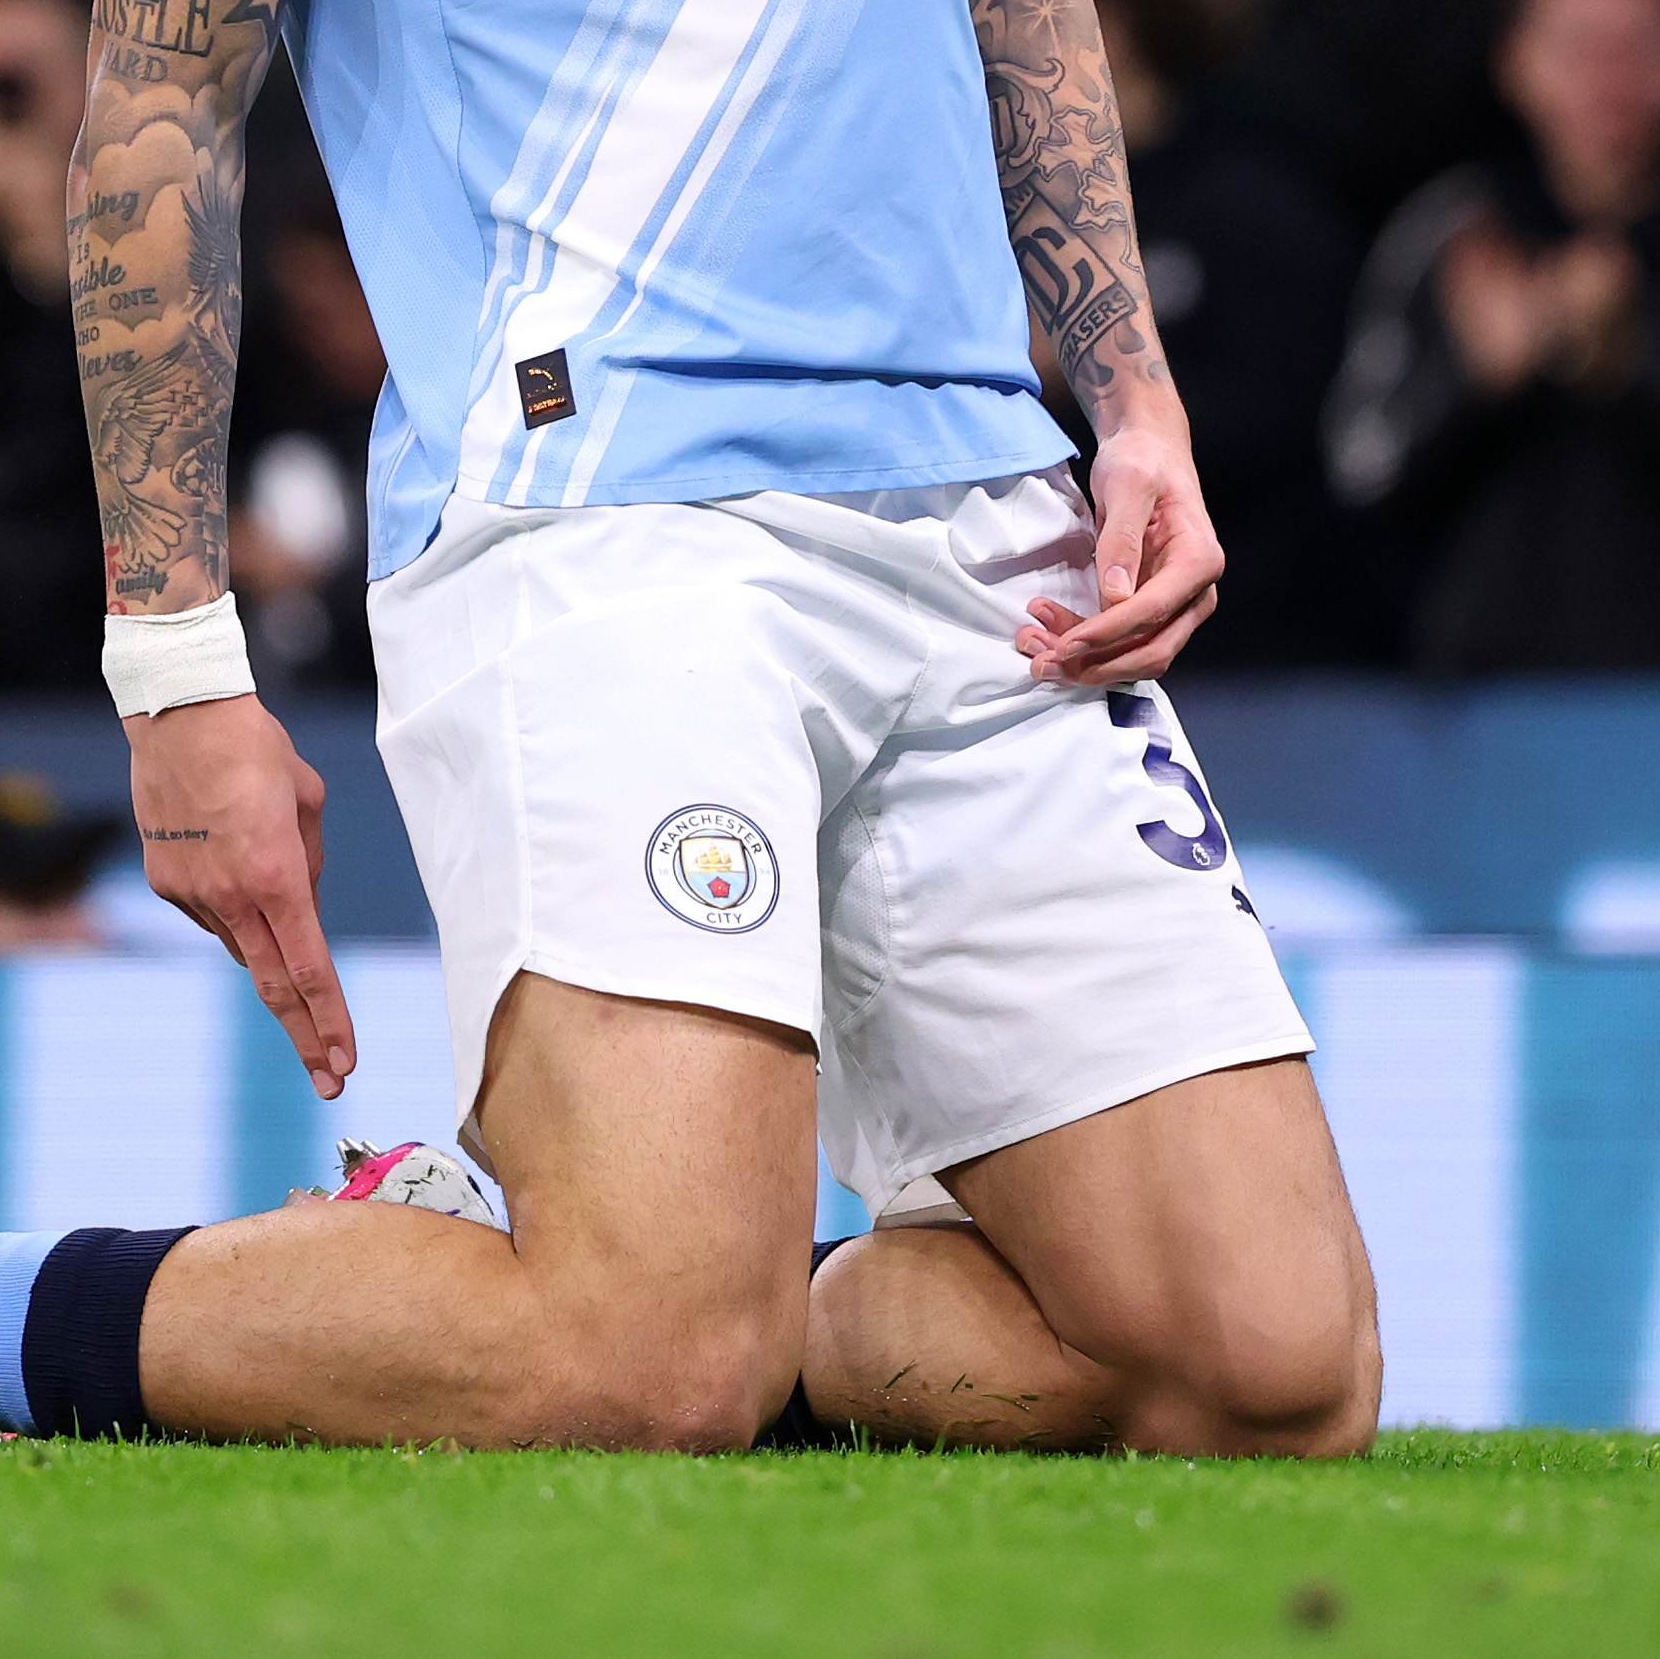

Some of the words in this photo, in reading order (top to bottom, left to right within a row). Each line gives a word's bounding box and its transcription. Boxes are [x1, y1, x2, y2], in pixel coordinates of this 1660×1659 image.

[108, 286, 159, 312] ONE
[1060, 289, 1131, 364] HASERS
[659, 813, 762, 856] MANCHESTER
[706, 911, 743, 925] CITY
